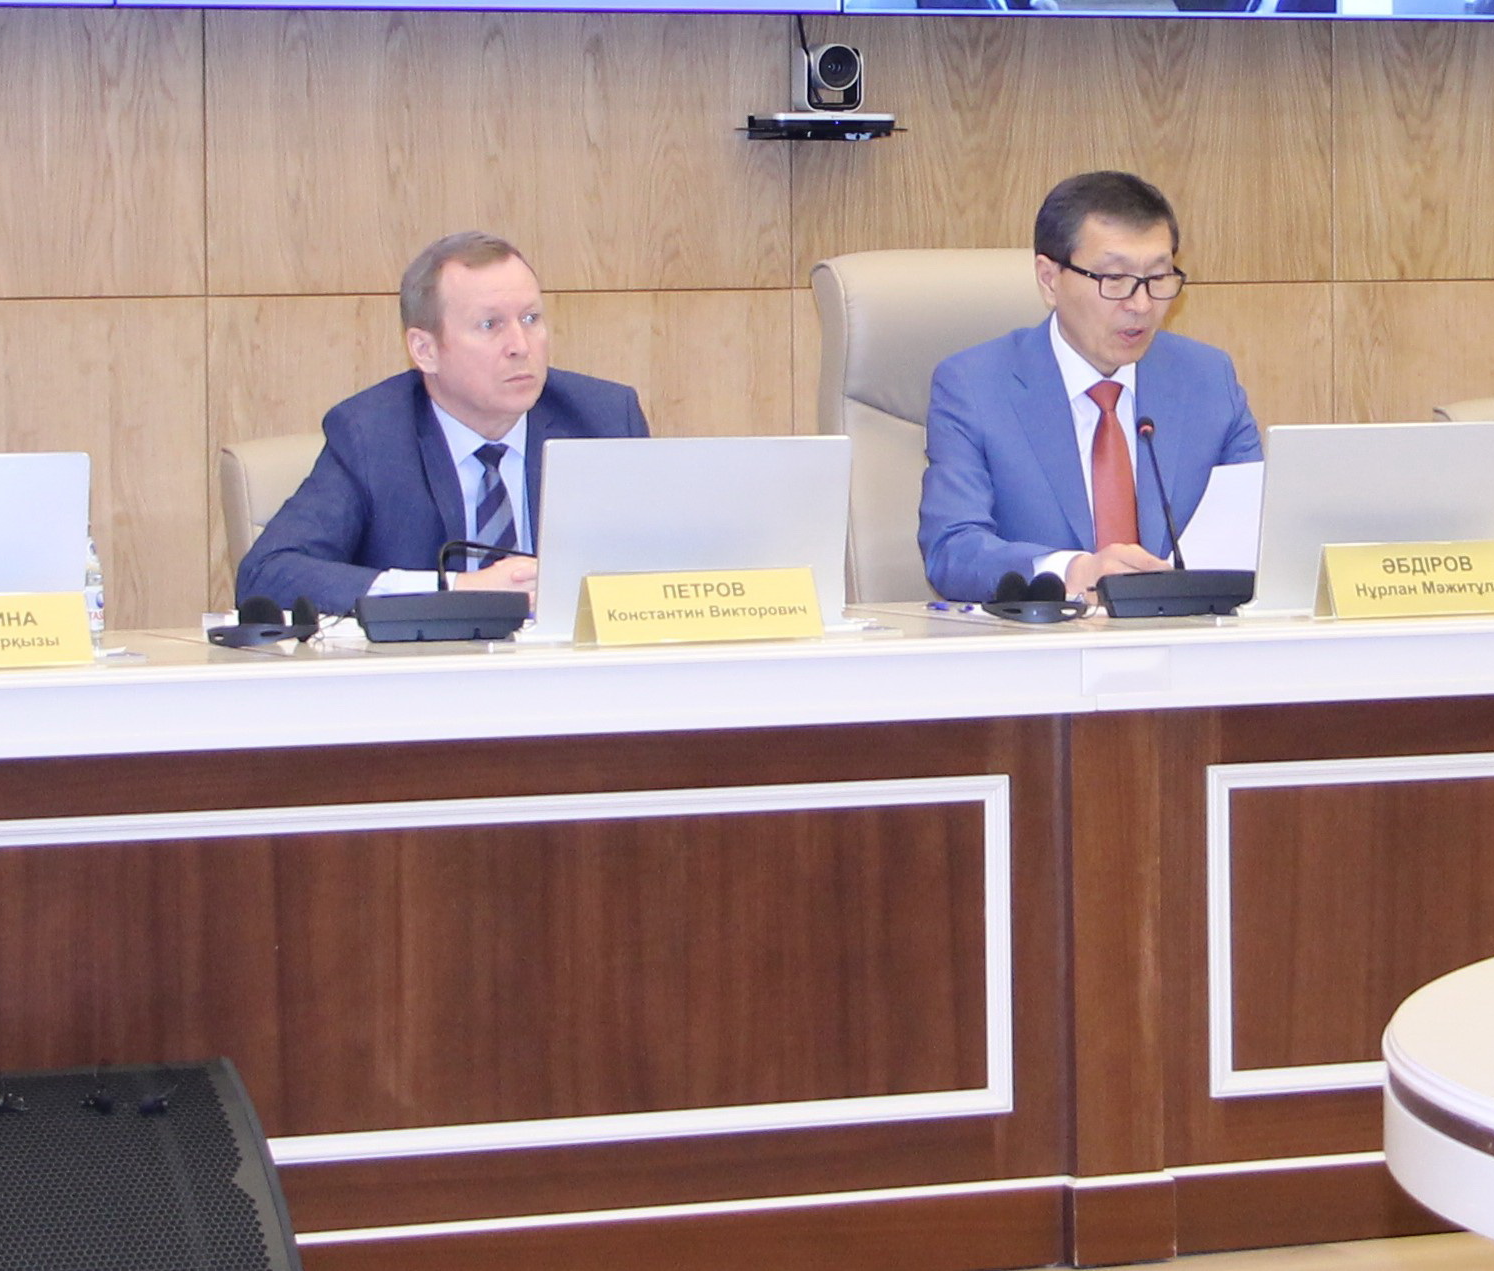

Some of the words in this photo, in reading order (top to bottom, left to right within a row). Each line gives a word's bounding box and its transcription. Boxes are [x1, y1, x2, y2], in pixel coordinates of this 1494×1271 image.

[1382, 556, 1473, 575] ӘБДІРОВ
[663, 582, 746, 600] ПЕТРОВ
[1356, 584, 1418, 599] Нұрлан
[607, 608, 705, 622] Константин
[709, 604, 807, 618] Викторович
